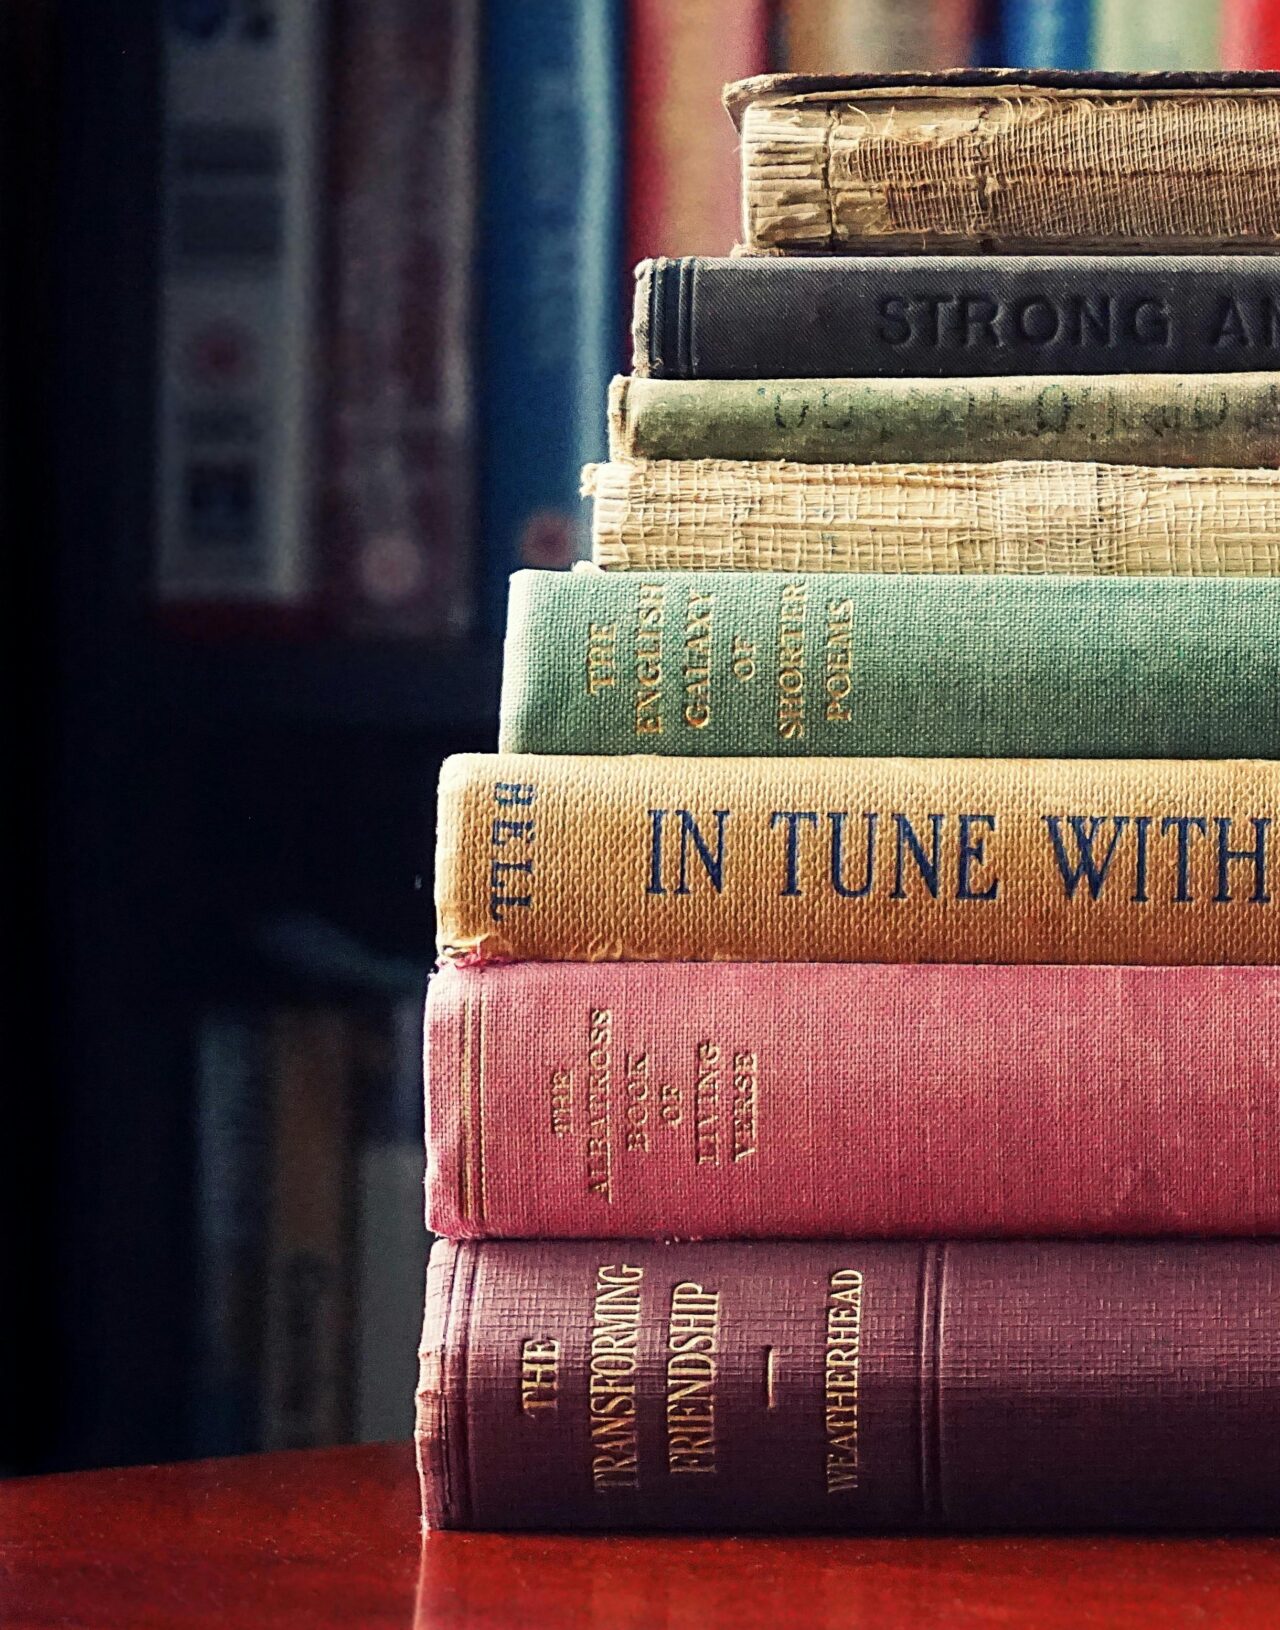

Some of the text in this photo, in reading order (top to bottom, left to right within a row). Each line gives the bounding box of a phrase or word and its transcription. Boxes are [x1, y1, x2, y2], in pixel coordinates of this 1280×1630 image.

[877, 294, 1174, 349] STRONG
[587, 622, 616, 695] THE
[635, 582, 664, 736] ENGLISH
[683, 590, 715, 729] GALAXY
[731, 635, 757, 681] OF
[777, 581, 808, 740] SHORTER
[825, 598, 853, 722] POEMS
[645, 809, 728, 895] IN
[771, 811, 999, 901] TUNE
[1041, 815, 1271, 903] WITH
[551, 1069, 574, 1138] THE
[588, 1007, 612, 1203] ALBATROSS
[626, 1052, 648, 1152] BOOK
[660, 1084, 681, 1125] OF
[697, 1040, 720, 1165] LIVING
[733, 1052, 757, 1163] VERSE
[521, 1338, 560, 1419] THE
[589, 1263, 643, 1494] TRANSFORMING
[667, 1281, 720, 1475] FRIENDSHIP
[825, 1269, 863, 1494] WEATHERHEAD
